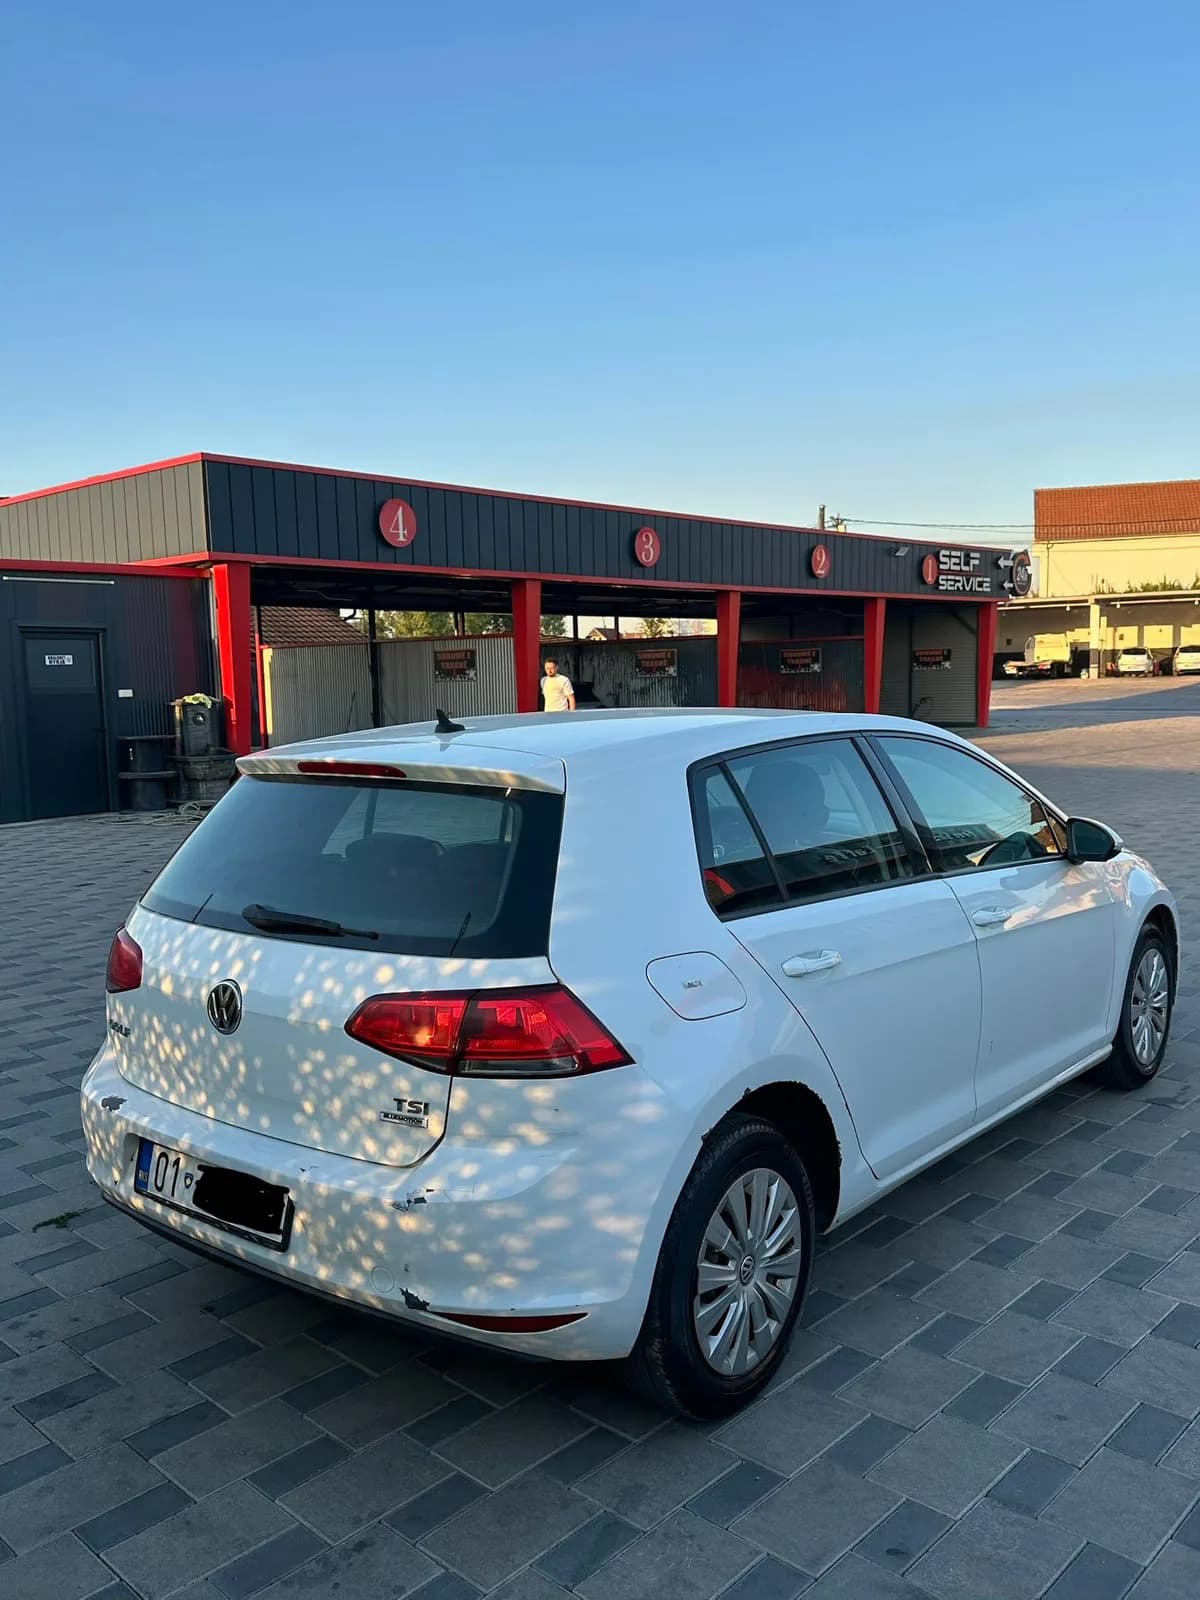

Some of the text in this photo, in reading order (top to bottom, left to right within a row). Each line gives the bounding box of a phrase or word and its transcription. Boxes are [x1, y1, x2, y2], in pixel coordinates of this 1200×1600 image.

[389, 505, 408, 542] 4
[642, 531, 654, 562] 3
[816, 548, 826, 574] 2
[939, 550, 981, 572] SELF
[938, 574, 992, 592] SERVICE
[393, 1097, 430, 1116] TSI
[154, 1151, 182, 1198] 01
